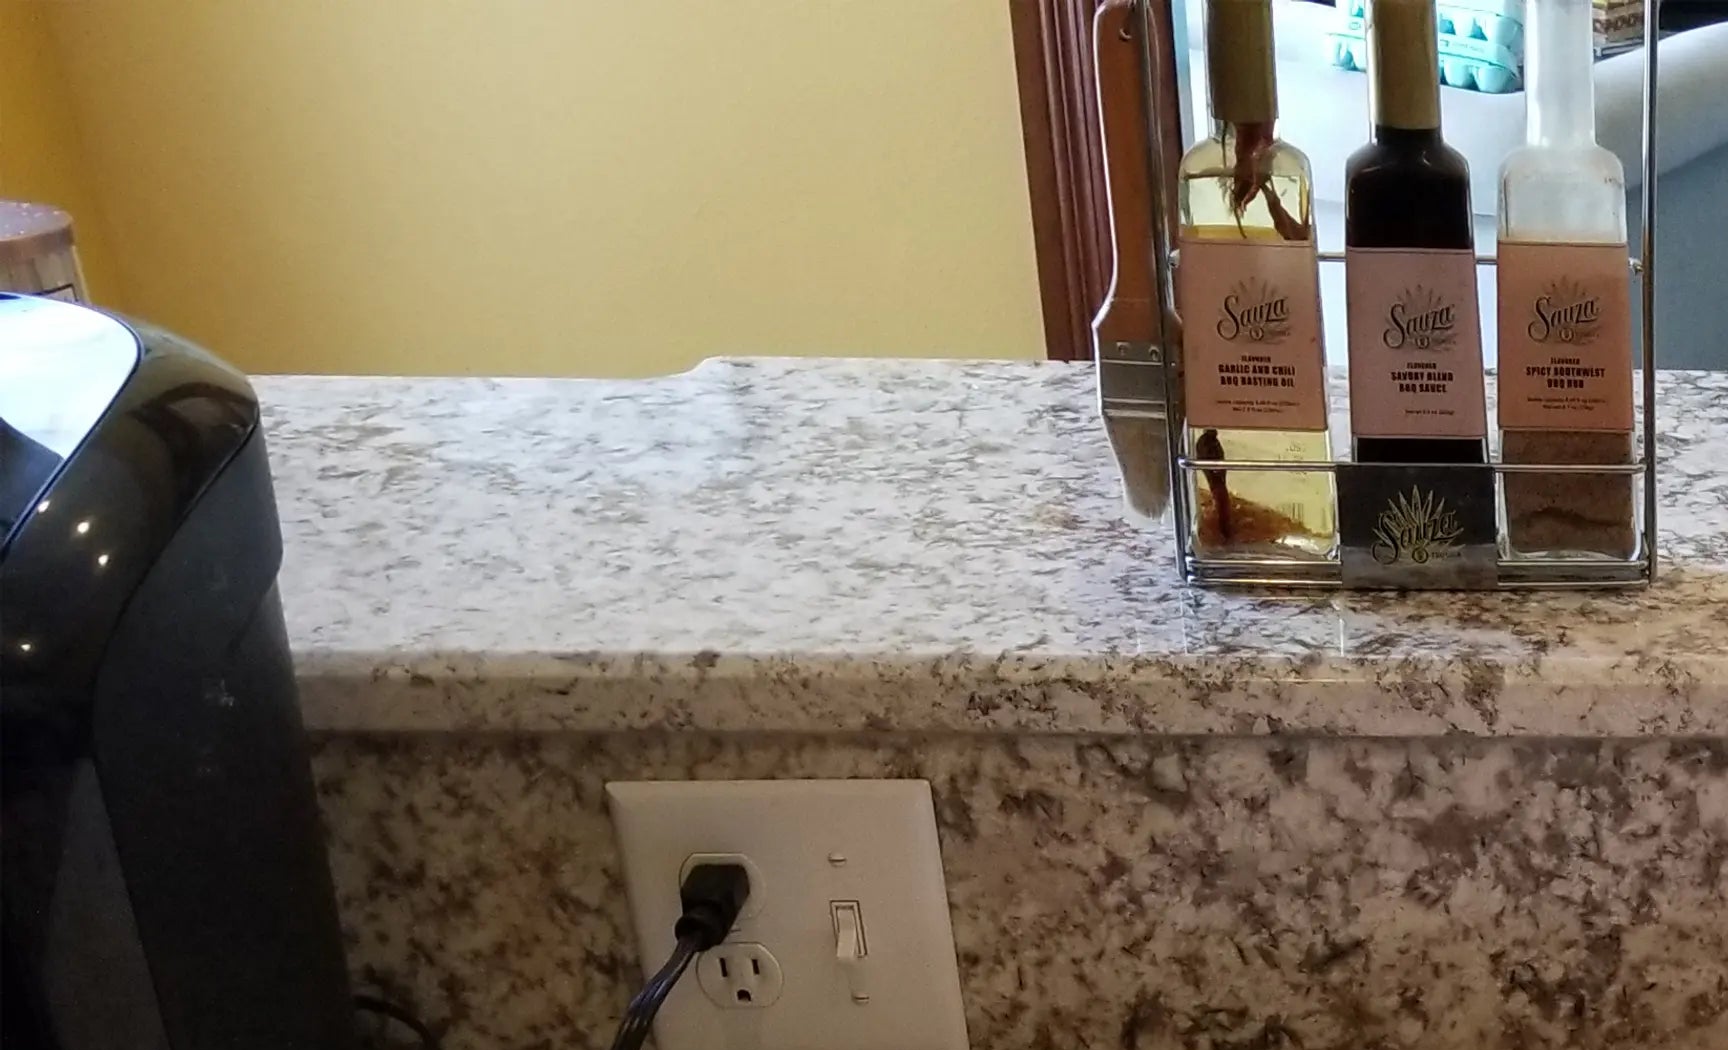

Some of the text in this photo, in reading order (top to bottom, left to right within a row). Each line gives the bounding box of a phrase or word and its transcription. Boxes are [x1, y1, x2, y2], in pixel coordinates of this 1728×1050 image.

[1217, 294, 1289, 341] Sauza
[1527, 296, 1599, 343] Sauza
[1383, 303, 1455, 349] Sauza
[1218, 364, 1250, 374] GARLIC
[1252, 364, 1270, 374] AND
[1526, 366, 1606, 378] SPICY SOUTHWEST
[1220, 376, 1295, 388] BBQ BASTING OIL
[1391, 371, 1454, 382] SAVORY BLEND
[1399, 383, 1447, 393] BBQ SAUCE
[1372, 510, 1464, 565] Sauza
